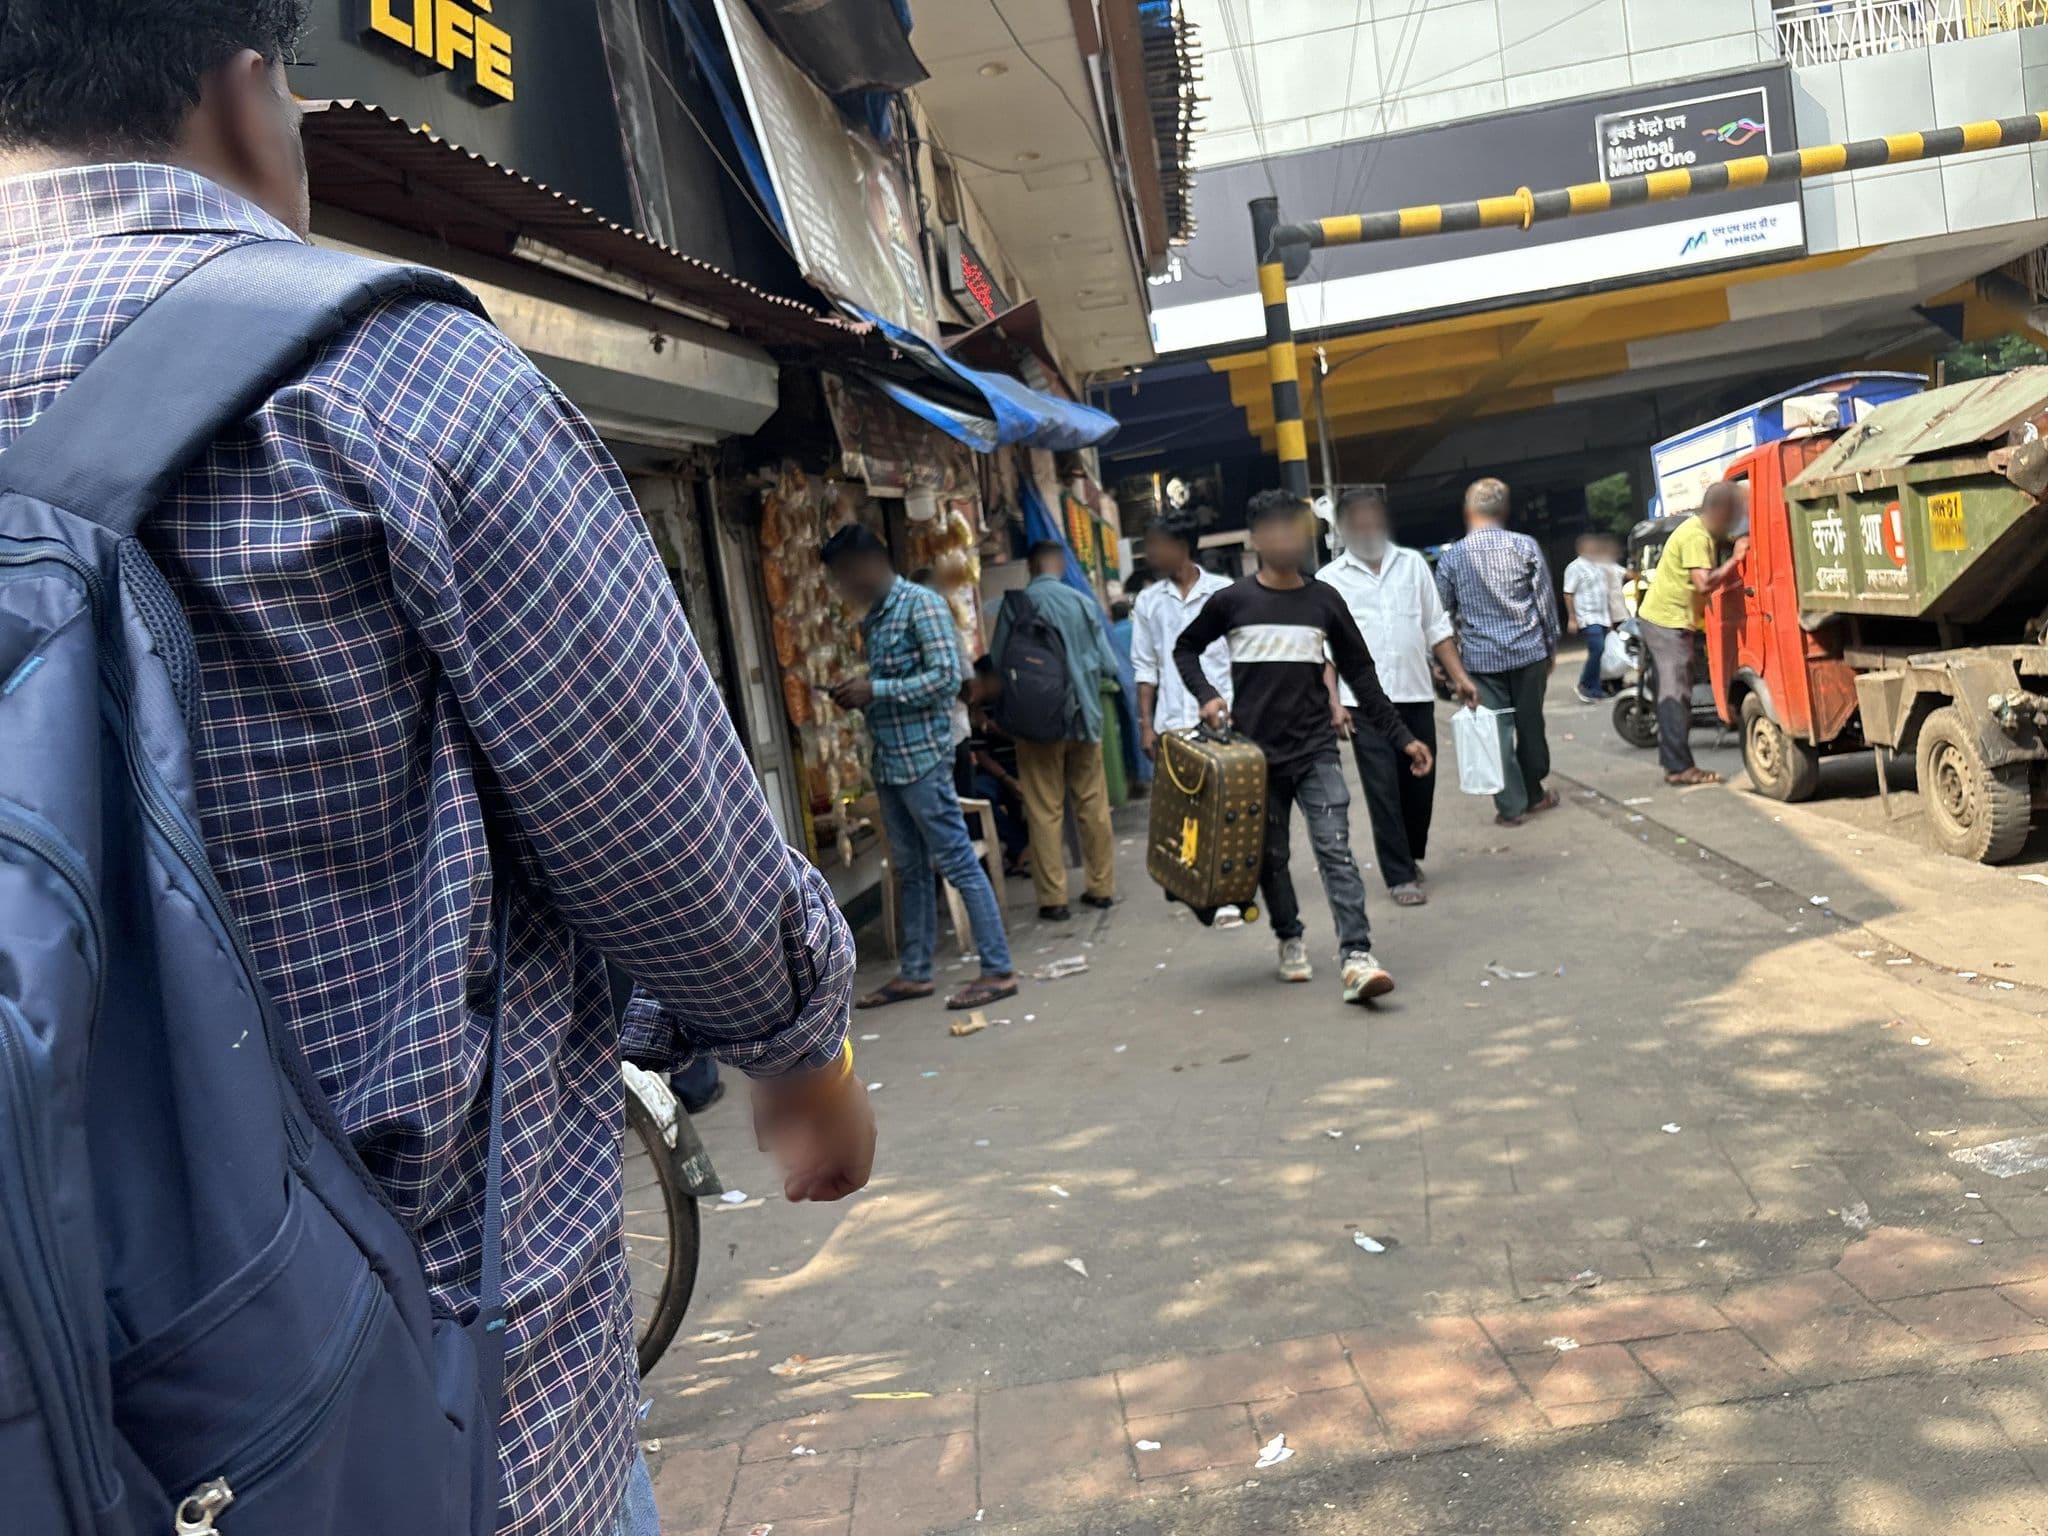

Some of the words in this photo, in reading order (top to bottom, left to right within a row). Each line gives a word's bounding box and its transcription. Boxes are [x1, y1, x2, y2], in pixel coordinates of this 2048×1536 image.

[370, 0, 514, 101] LIFE
[1608, 137, 1674, 162] Mumbai
[1660, 151, 1696, 168] One
